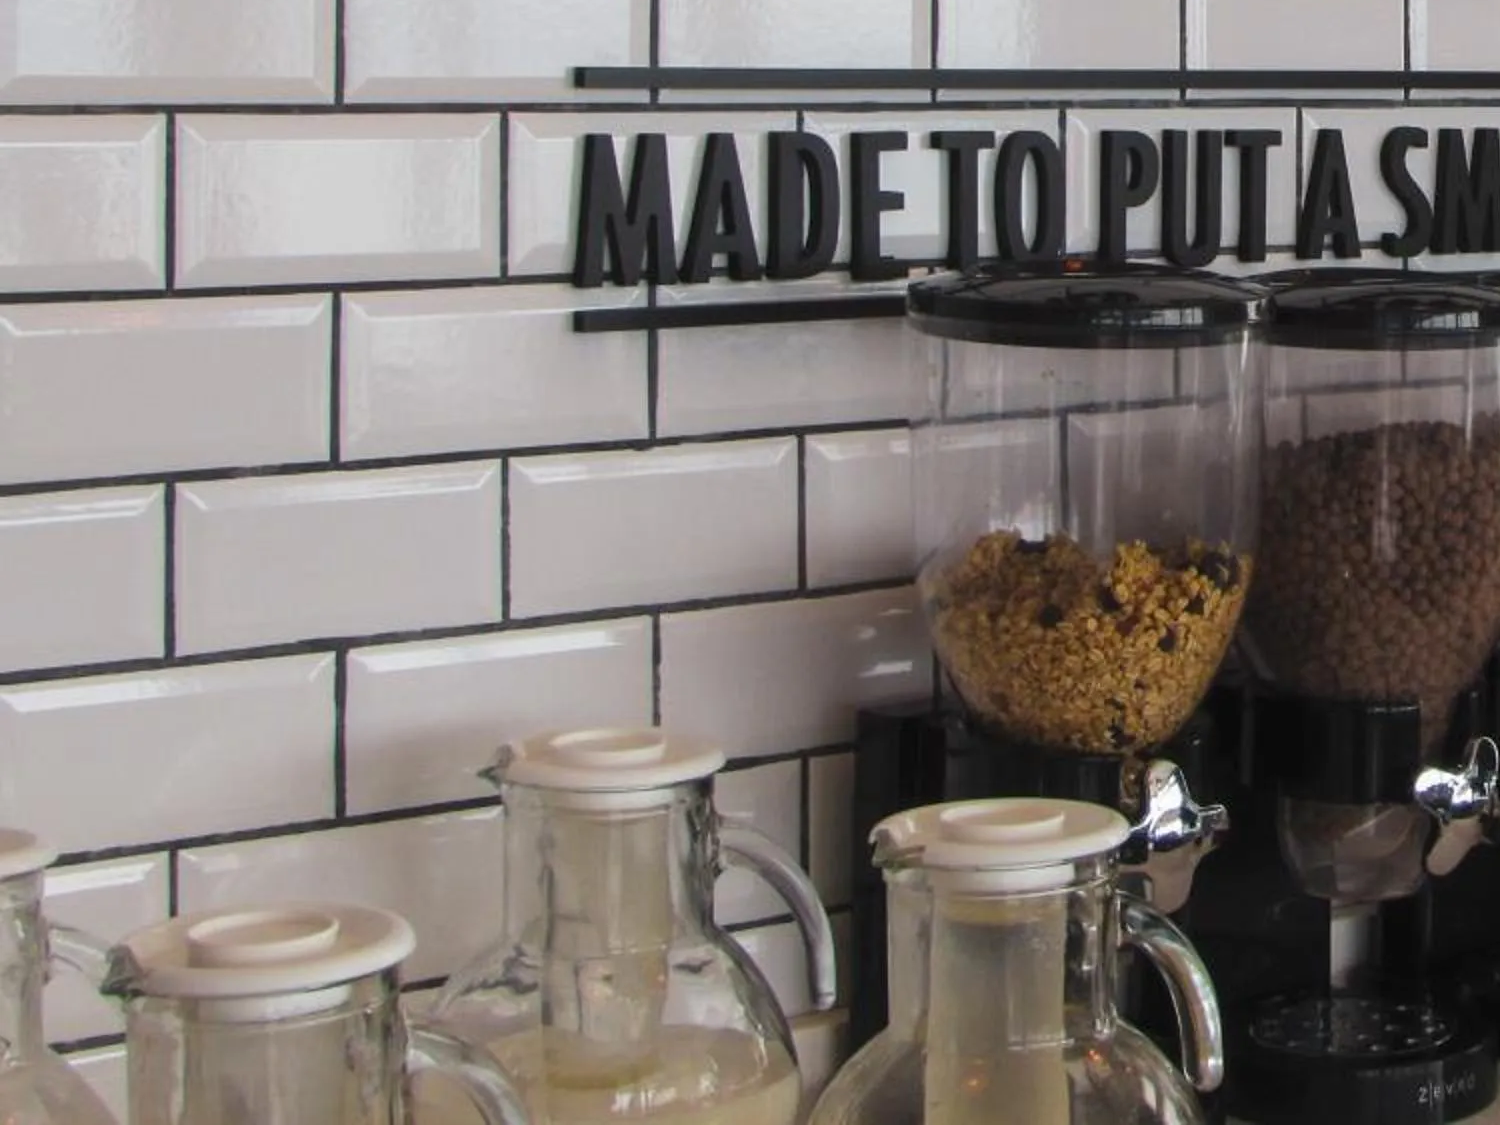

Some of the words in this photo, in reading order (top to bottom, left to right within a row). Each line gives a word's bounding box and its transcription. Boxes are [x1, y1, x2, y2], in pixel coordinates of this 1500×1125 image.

[572, 130, 908, 288] MADE
[930, 129, 1064, 272] TO
[1096, 128, 1282, 268] PUT
[1295, 128, 1361, 260] A
